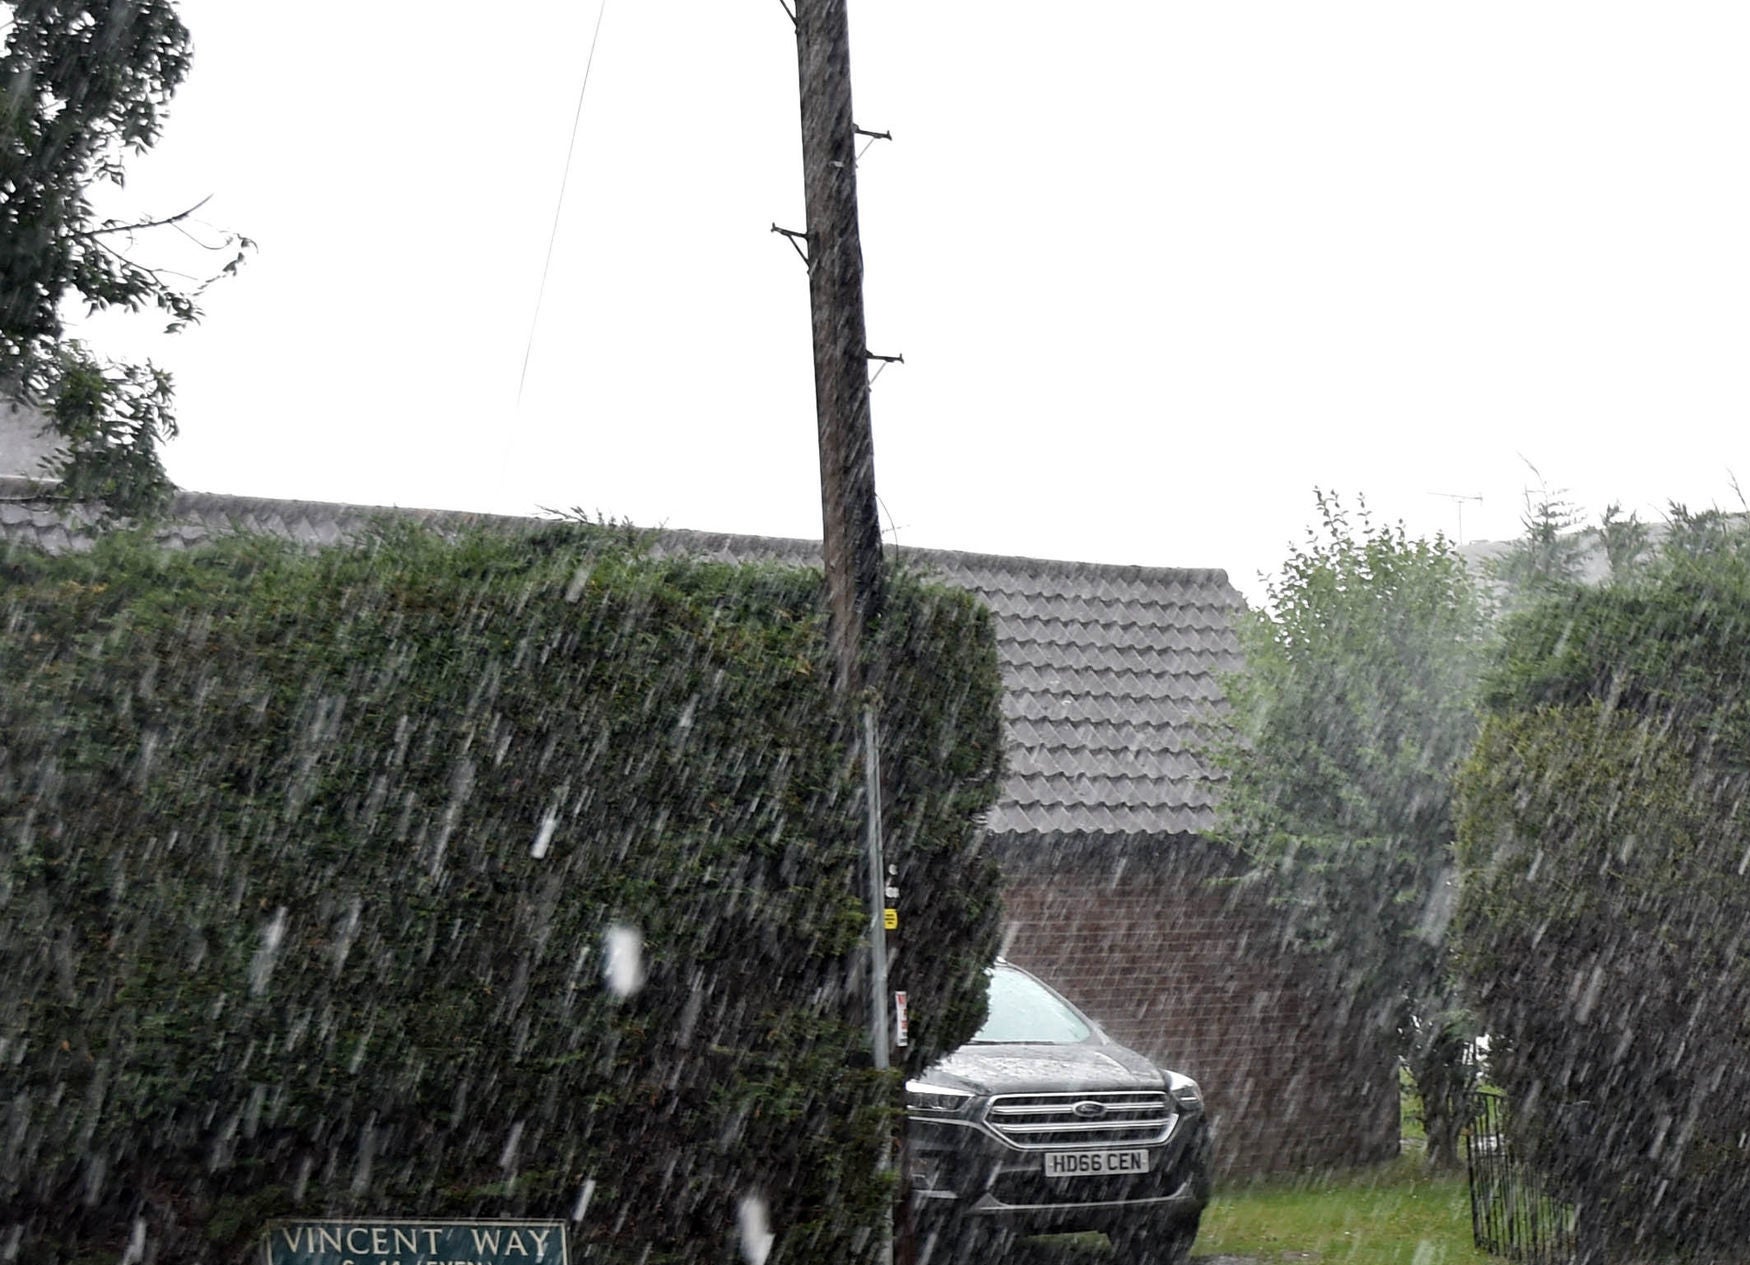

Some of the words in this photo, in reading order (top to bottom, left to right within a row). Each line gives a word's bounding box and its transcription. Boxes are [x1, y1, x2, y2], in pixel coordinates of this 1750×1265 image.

[1053, 1154, 1102, 1173] HD66
[1107, 1152, 1142, 1171] CEN
[280, 1227, 442, 1255] VINCENT
[470, 1228, 551, 1257] WAY
